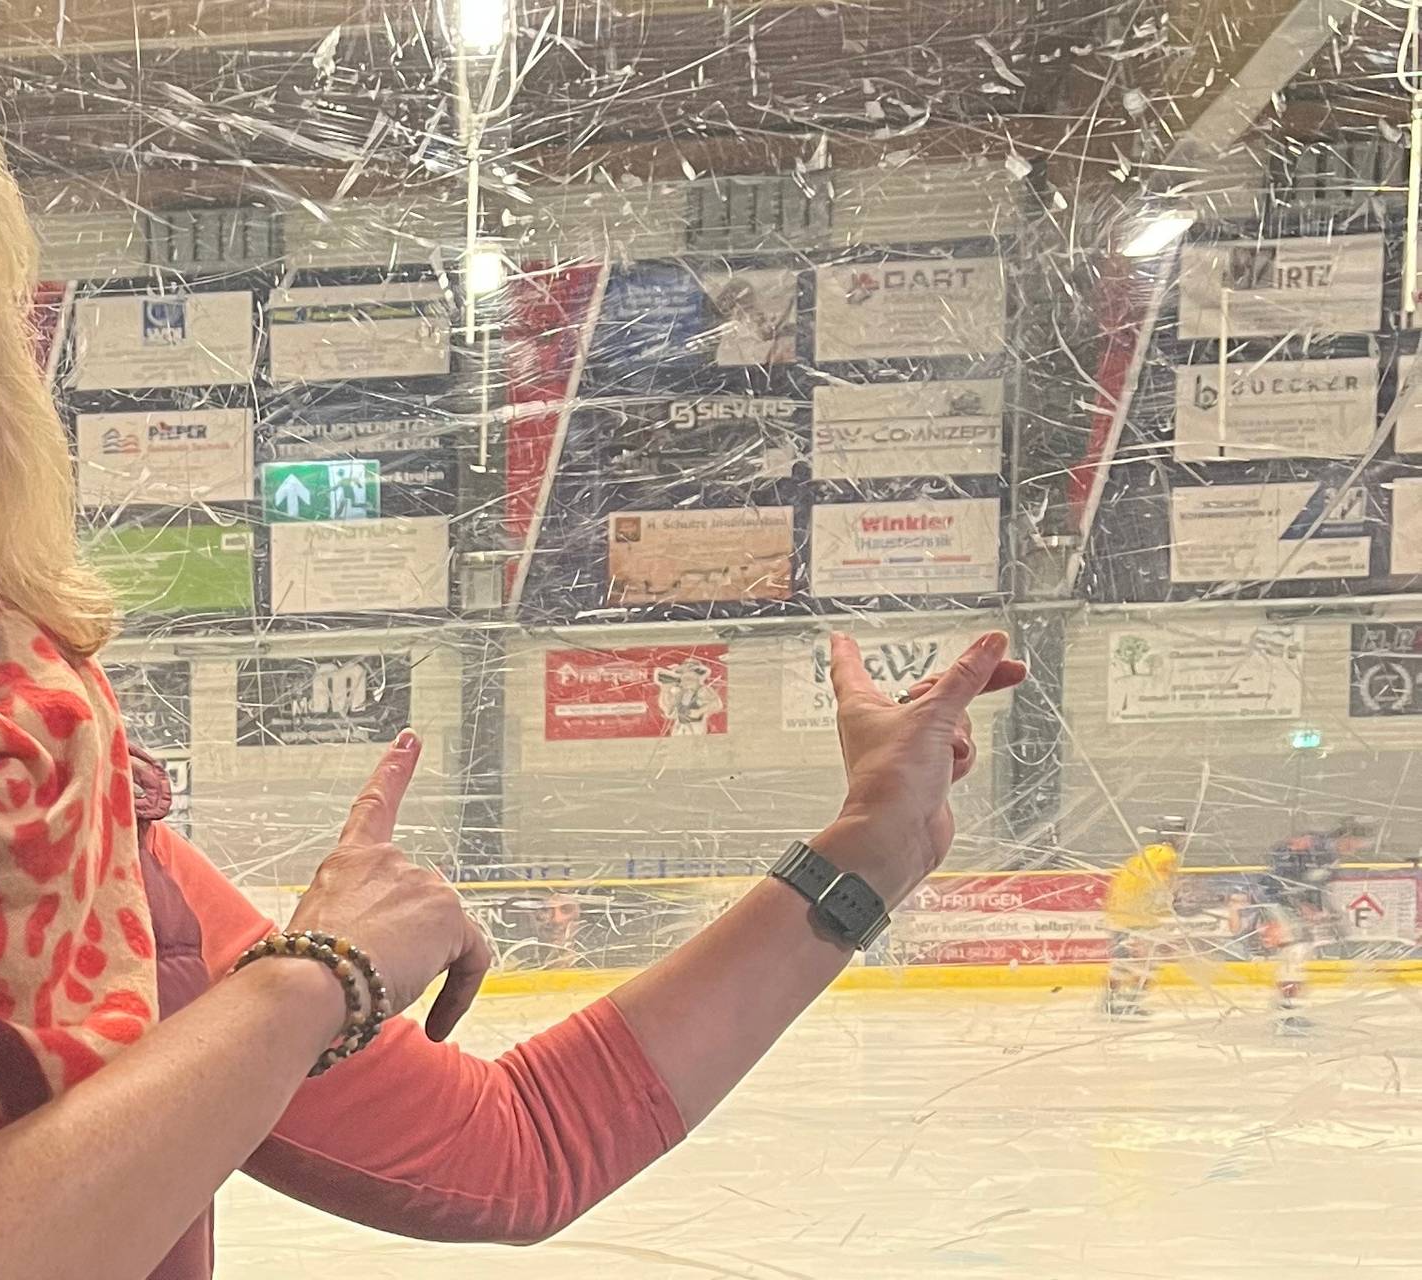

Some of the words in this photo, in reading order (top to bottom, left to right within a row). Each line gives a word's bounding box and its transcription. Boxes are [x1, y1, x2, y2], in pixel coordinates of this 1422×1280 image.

[884, 268, 974, 289] DART
[697, 399, 794, 420] SIEVERS
[862, 513, 955, 532] Winkler
[942, 893, 1024, 908] FRITTGEN
